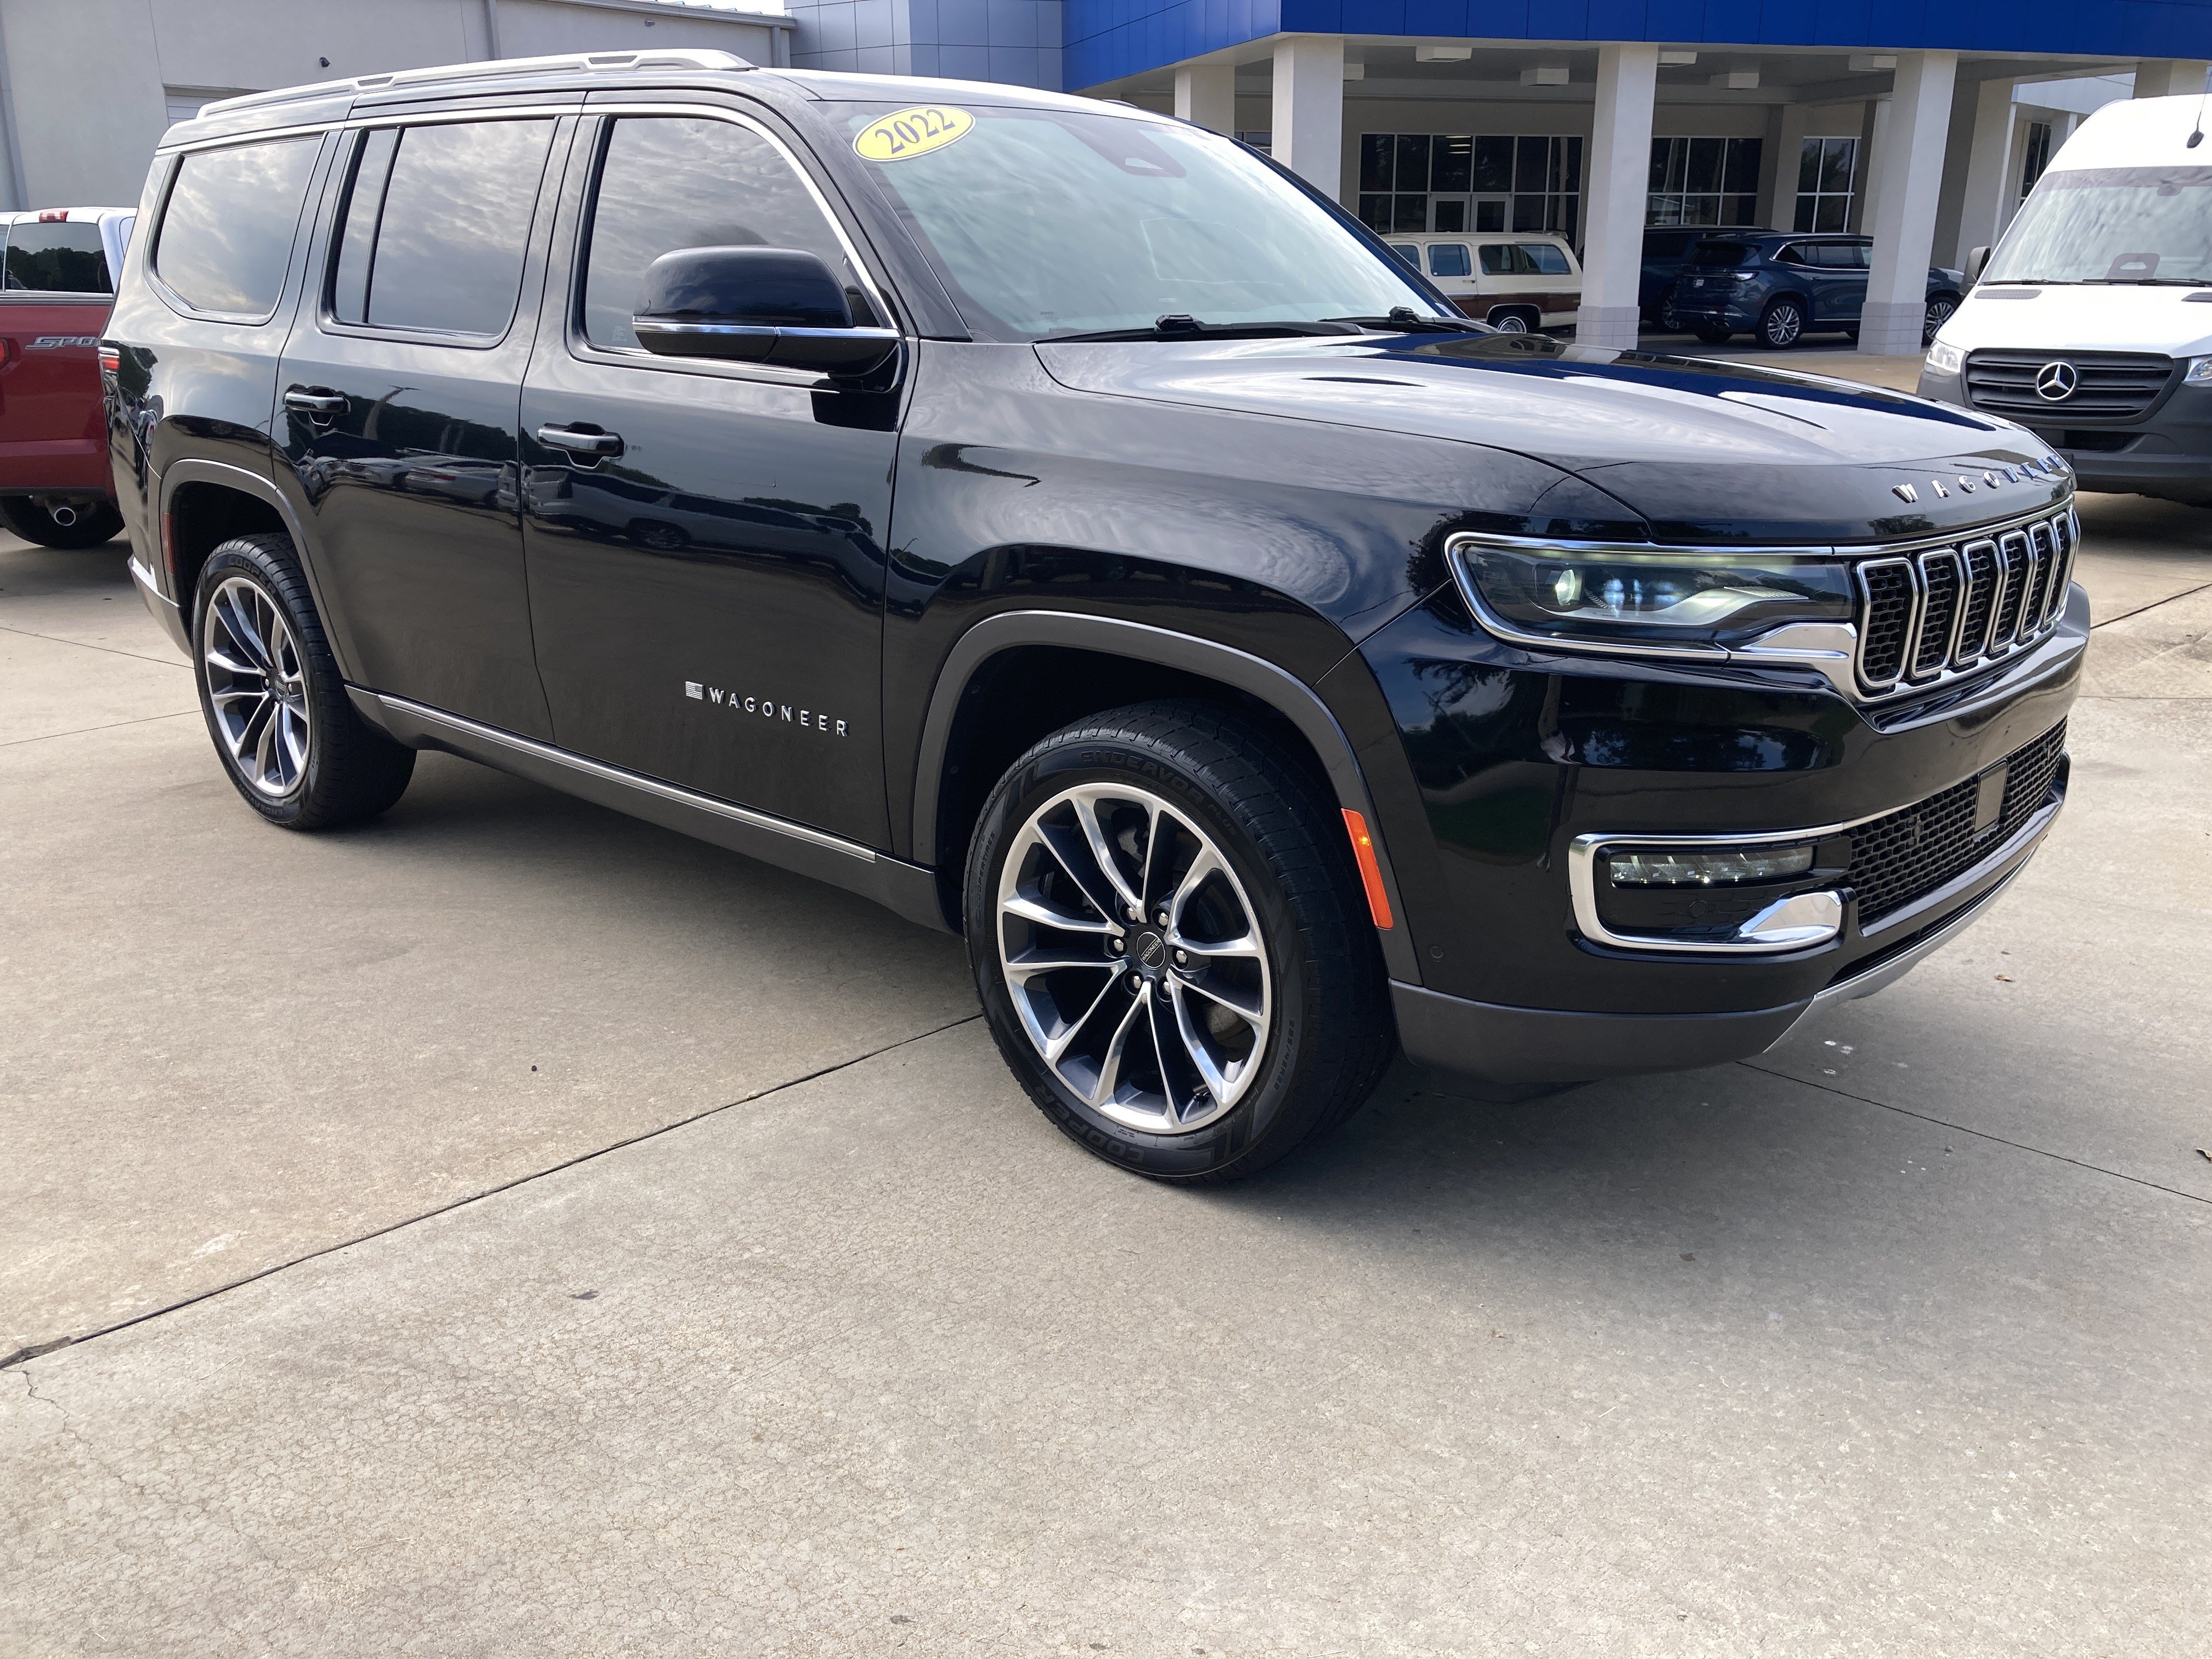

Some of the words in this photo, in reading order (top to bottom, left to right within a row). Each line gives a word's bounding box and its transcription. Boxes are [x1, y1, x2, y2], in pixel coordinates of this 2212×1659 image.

[875, 109, 955, 154] 2022
[25, 336, 101, 349] SPO
[1891, 454, 2063, 504] WAGONEER
[709, 687, 849, 737] WAGONEER
[1080, 751, 1205, 804] ENDEAVOR
[1141, 939, 1161, 961] WAGONEER
[1035, 1085, 1145, 1164] COOPER
